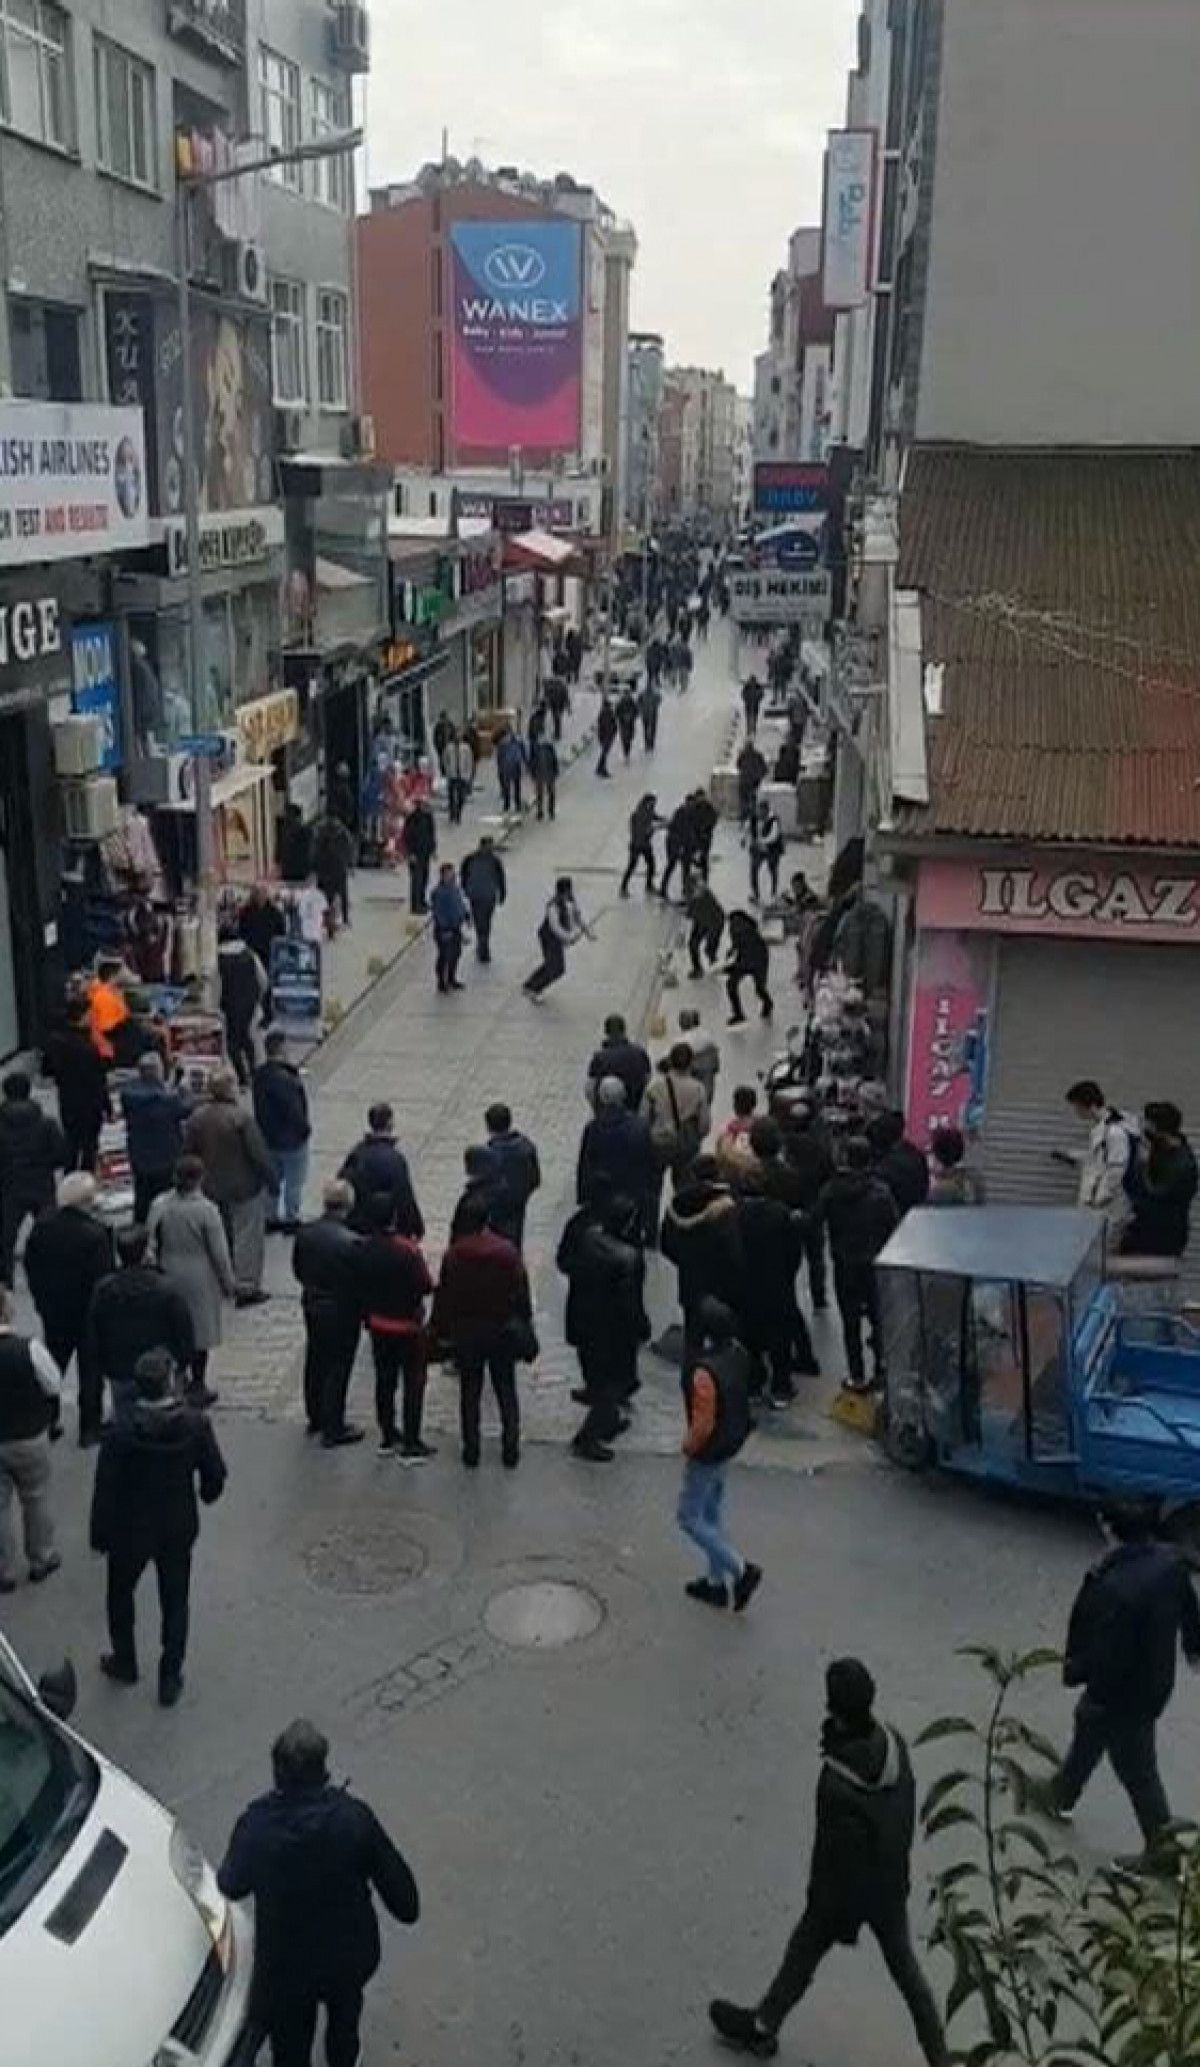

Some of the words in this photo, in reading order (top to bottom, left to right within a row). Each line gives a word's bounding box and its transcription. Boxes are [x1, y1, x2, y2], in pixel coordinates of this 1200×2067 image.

[462, 299, 569, 322] WANEX
[0, 439, 33, 476] ISH
[40, 440, 109, 475] AIRLINES
[980, 867, 1198, 926] ILGAZ
